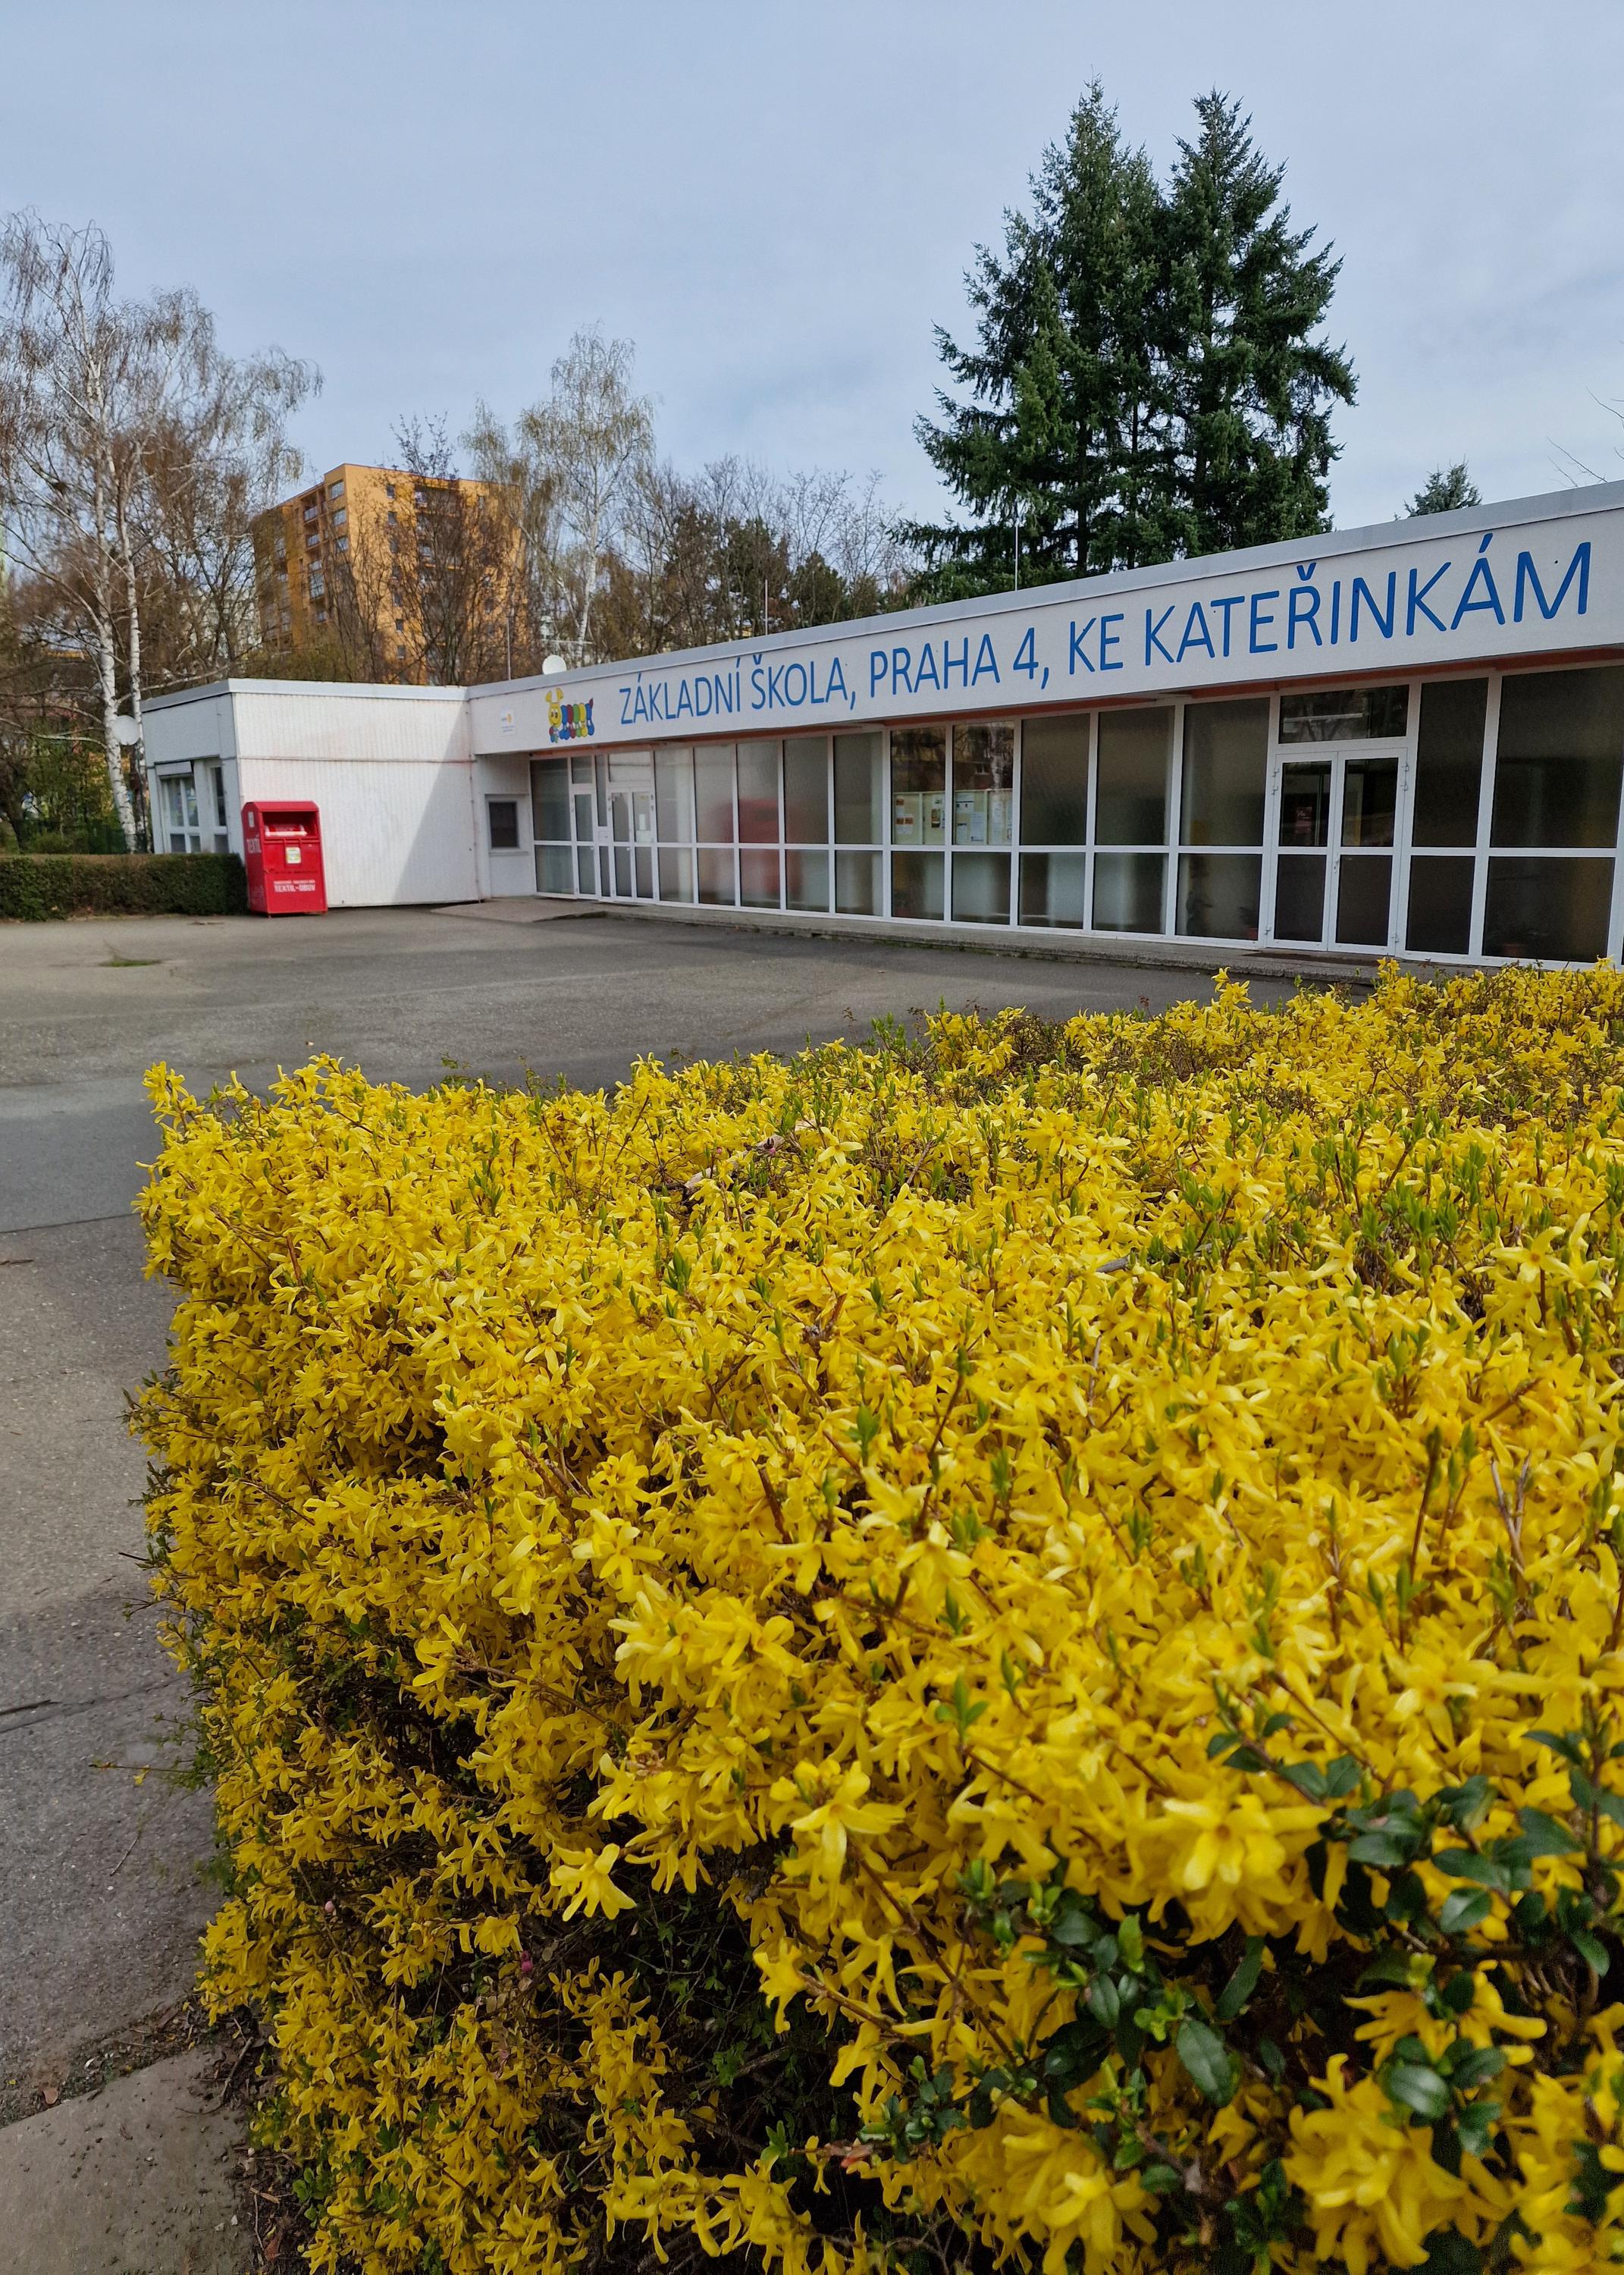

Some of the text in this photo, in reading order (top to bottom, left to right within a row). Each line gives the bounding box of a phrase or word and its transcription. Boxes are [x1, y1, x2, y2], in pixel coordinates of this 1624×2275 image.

[619, 532, 1592, 726] ZÁKLADNÍ ŠKOLA, PRAHA 4, KE KATEŘINKÁM
